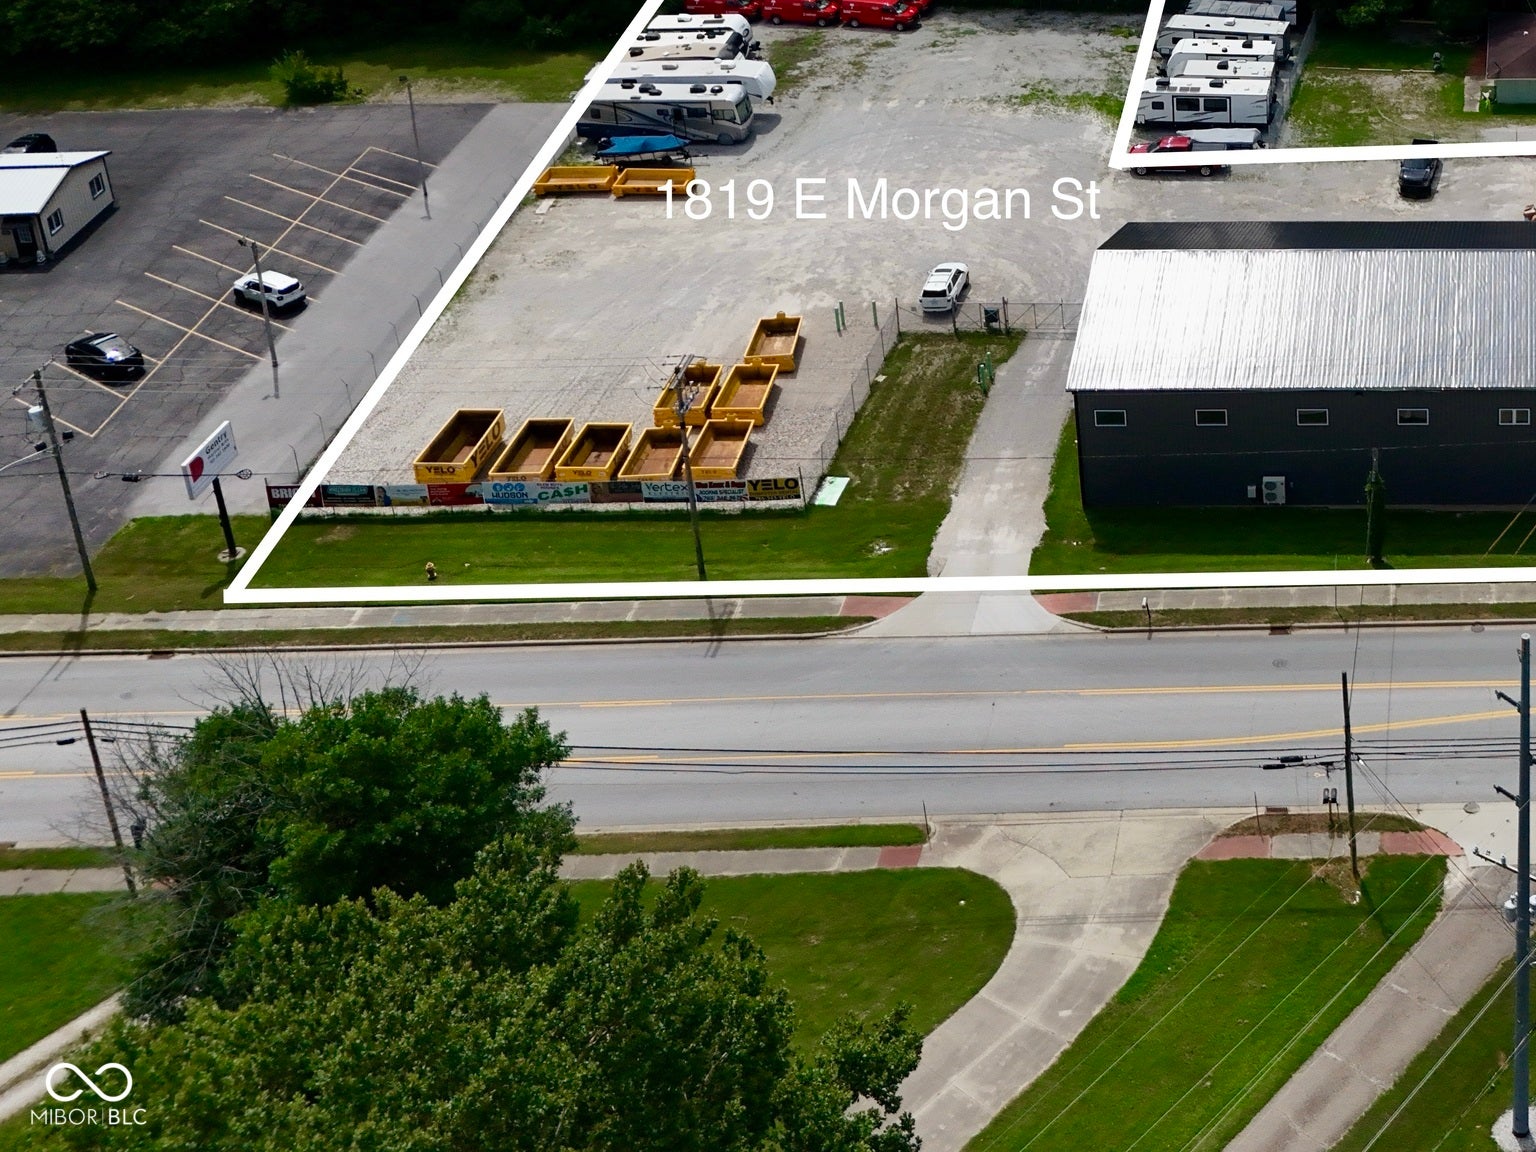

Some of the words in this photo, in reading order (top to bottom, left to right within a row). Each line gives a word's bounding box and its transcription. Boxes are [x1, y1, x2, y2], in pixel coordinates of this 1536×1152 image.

[205, 431, 227, 455] Gentry
[471, 421, 501, 468] YELO
[425, 465, 456, 474] YELO
[644, 481, 689, 492] Vertex
[747, 478, 799, 491] YELO
[491, 491, 529, 499] HUDSON
